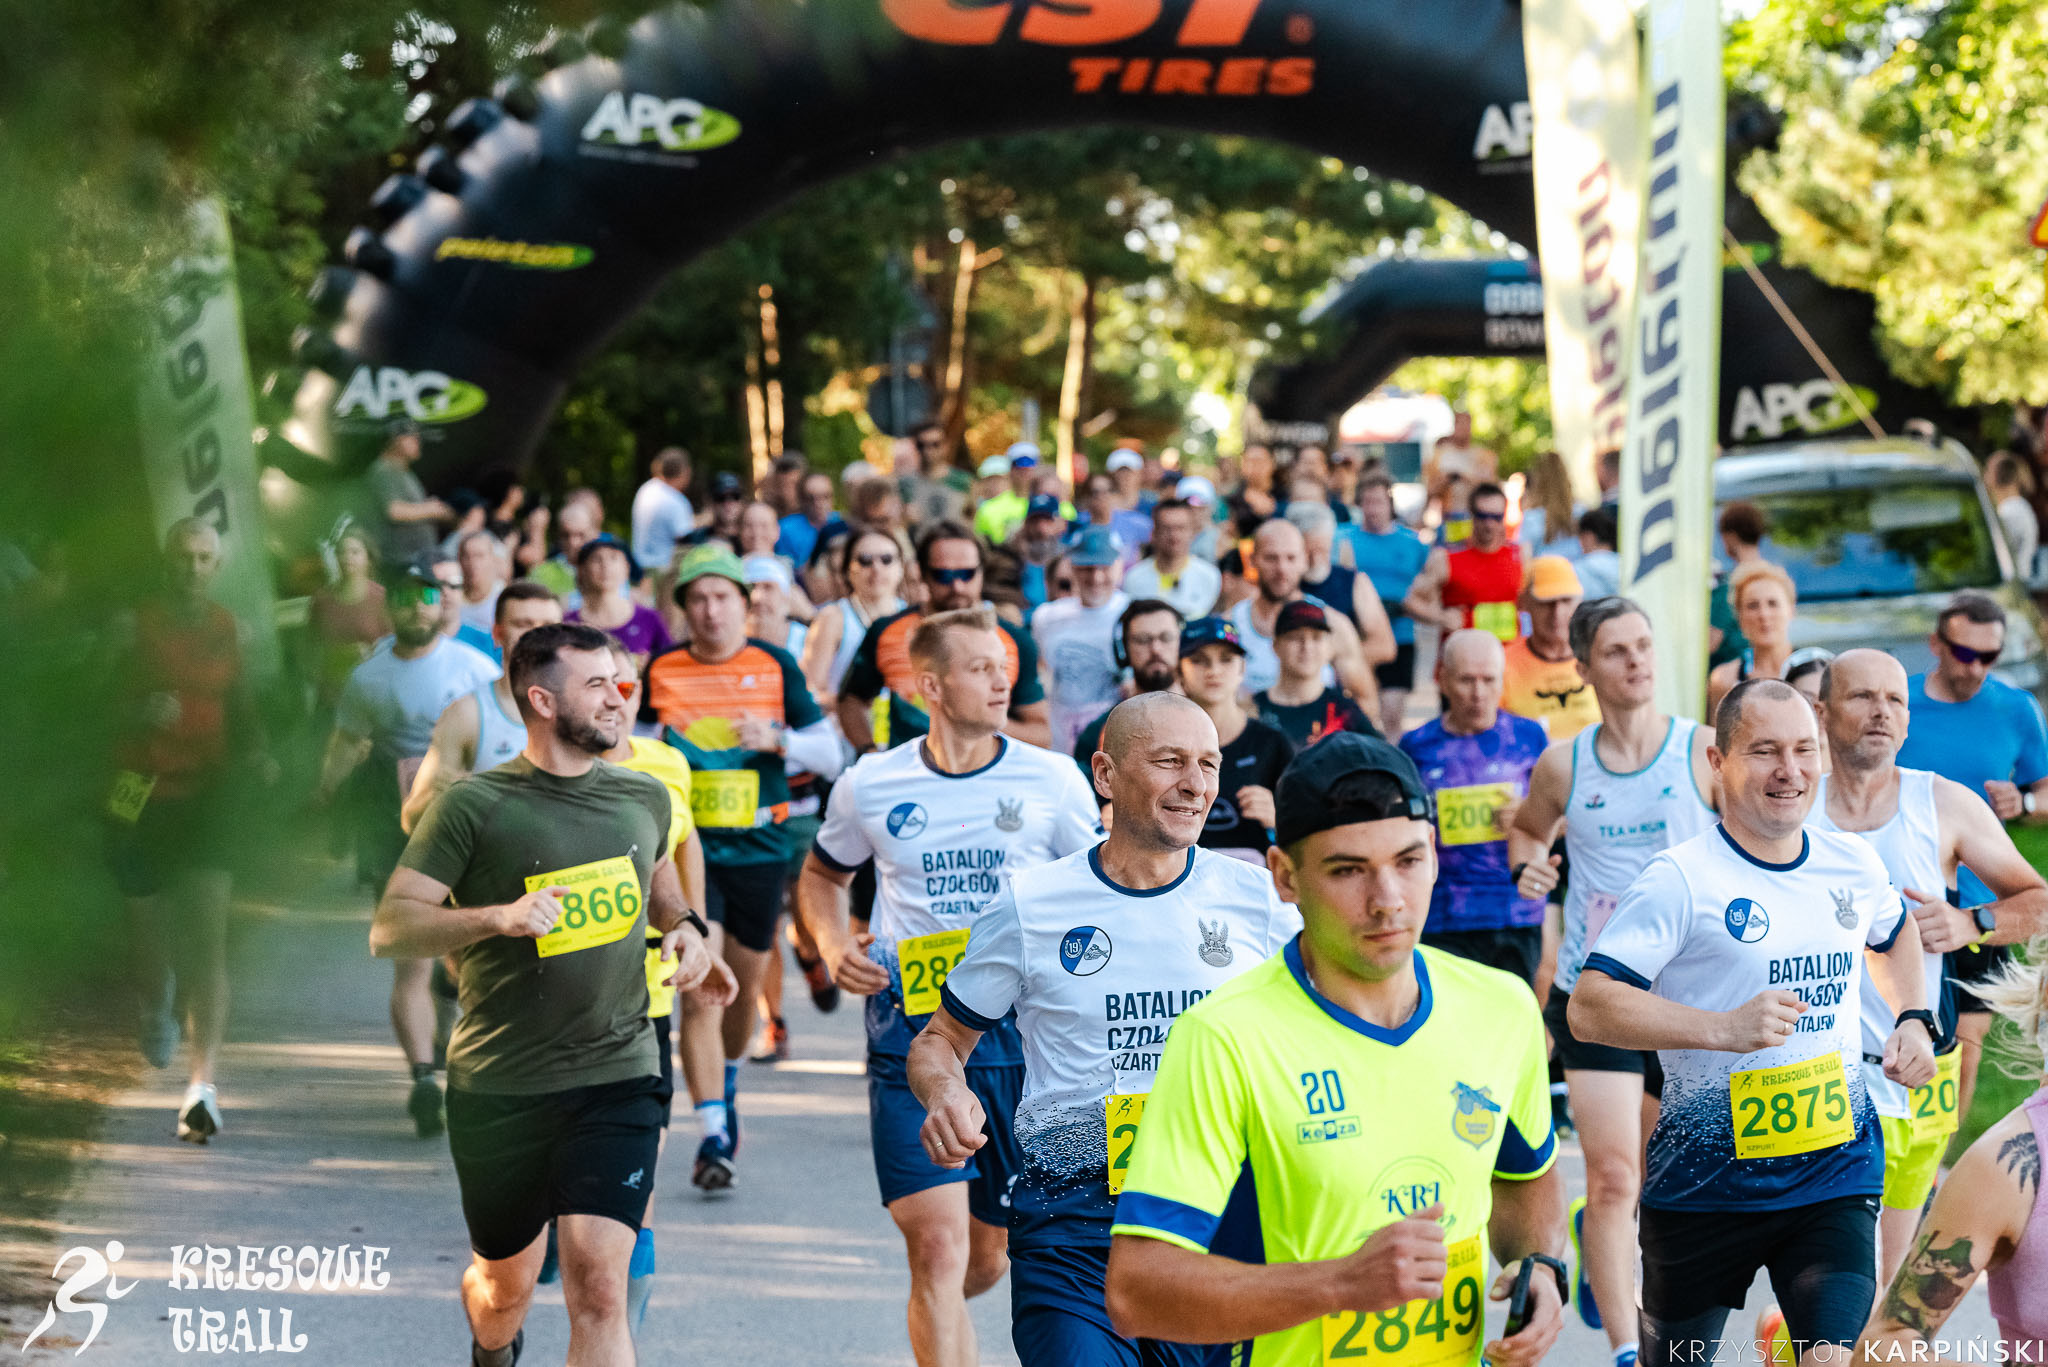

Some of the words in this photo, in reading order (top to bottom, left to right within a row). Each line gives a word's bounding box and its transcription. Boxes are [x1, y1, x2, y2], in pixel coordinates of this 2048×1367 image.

[1069, 57, 1315, 95] TIRES
[580, 89, 704, 147] APG
[1473, 101, 1534, 159] AP
[1729, 378, 1842, 441] APG
[1444, 803, 1493, 831] 200
[922, 849, 1006, 873] BATALION
[905, 951, 966, 995] 28
[1769, 951, 1853, 985] BATALION
[1111, 1052, 1162, 1072] CZART
[1761, 1066, 1812, 1087] KRESOWE
[1813, 1059, 1840, 1076] TRAIL
[1300, 1069, 1346, 1115] 20
[1739, 1078, 1847, 1138] 2875
[1328, 1276, 1480, 1360] 2849
